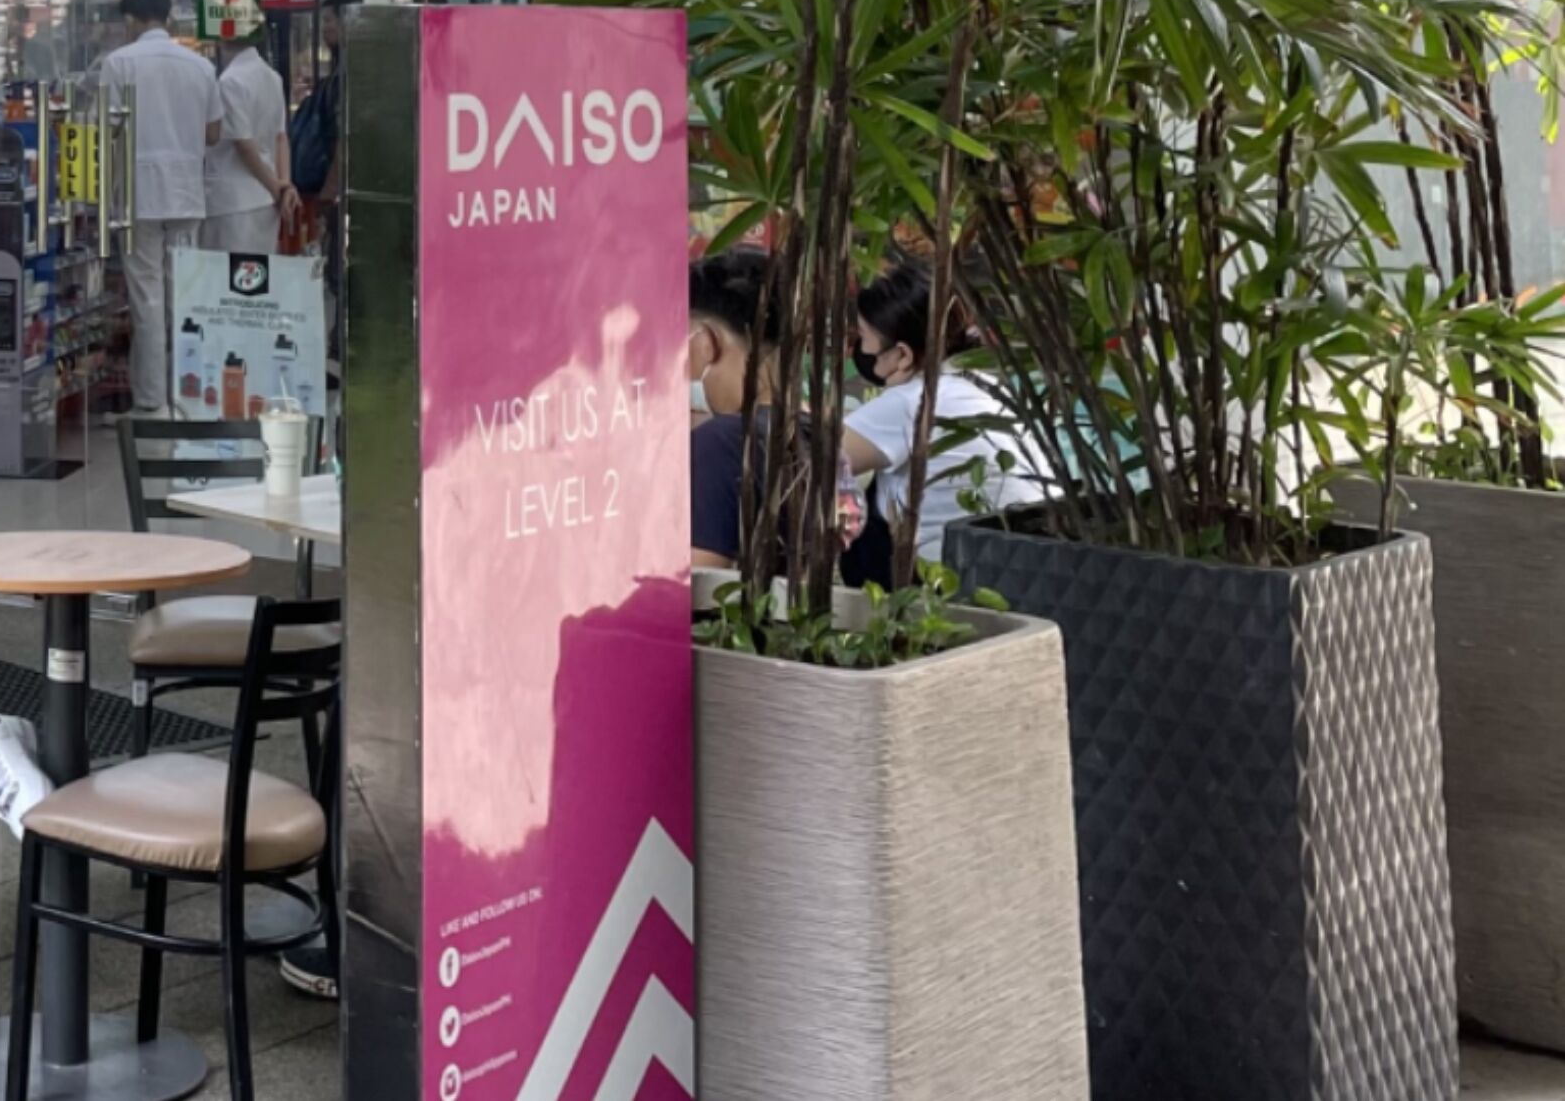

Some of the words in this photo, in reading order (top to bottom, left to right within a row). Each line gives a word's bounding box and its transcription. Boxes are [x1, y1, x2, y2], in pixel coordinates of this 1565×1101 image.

[66, 127, 79, 198] PULL
[447, 88, 664, 173] DAISO
[447, 186, 557, 229] JAPAN
[475, 394, 549, 454] VISIT
[562, 386, 598, 441] US
[609, 378, 647, 434] AT
[506, 476, 594, 540] LEVEL
[602, 469, 621, 519] 2
[440, 917, 459, 938] LIKE
[461, 910, 479, 929] AND
[479, 898, 515, 922] FOLLOW
